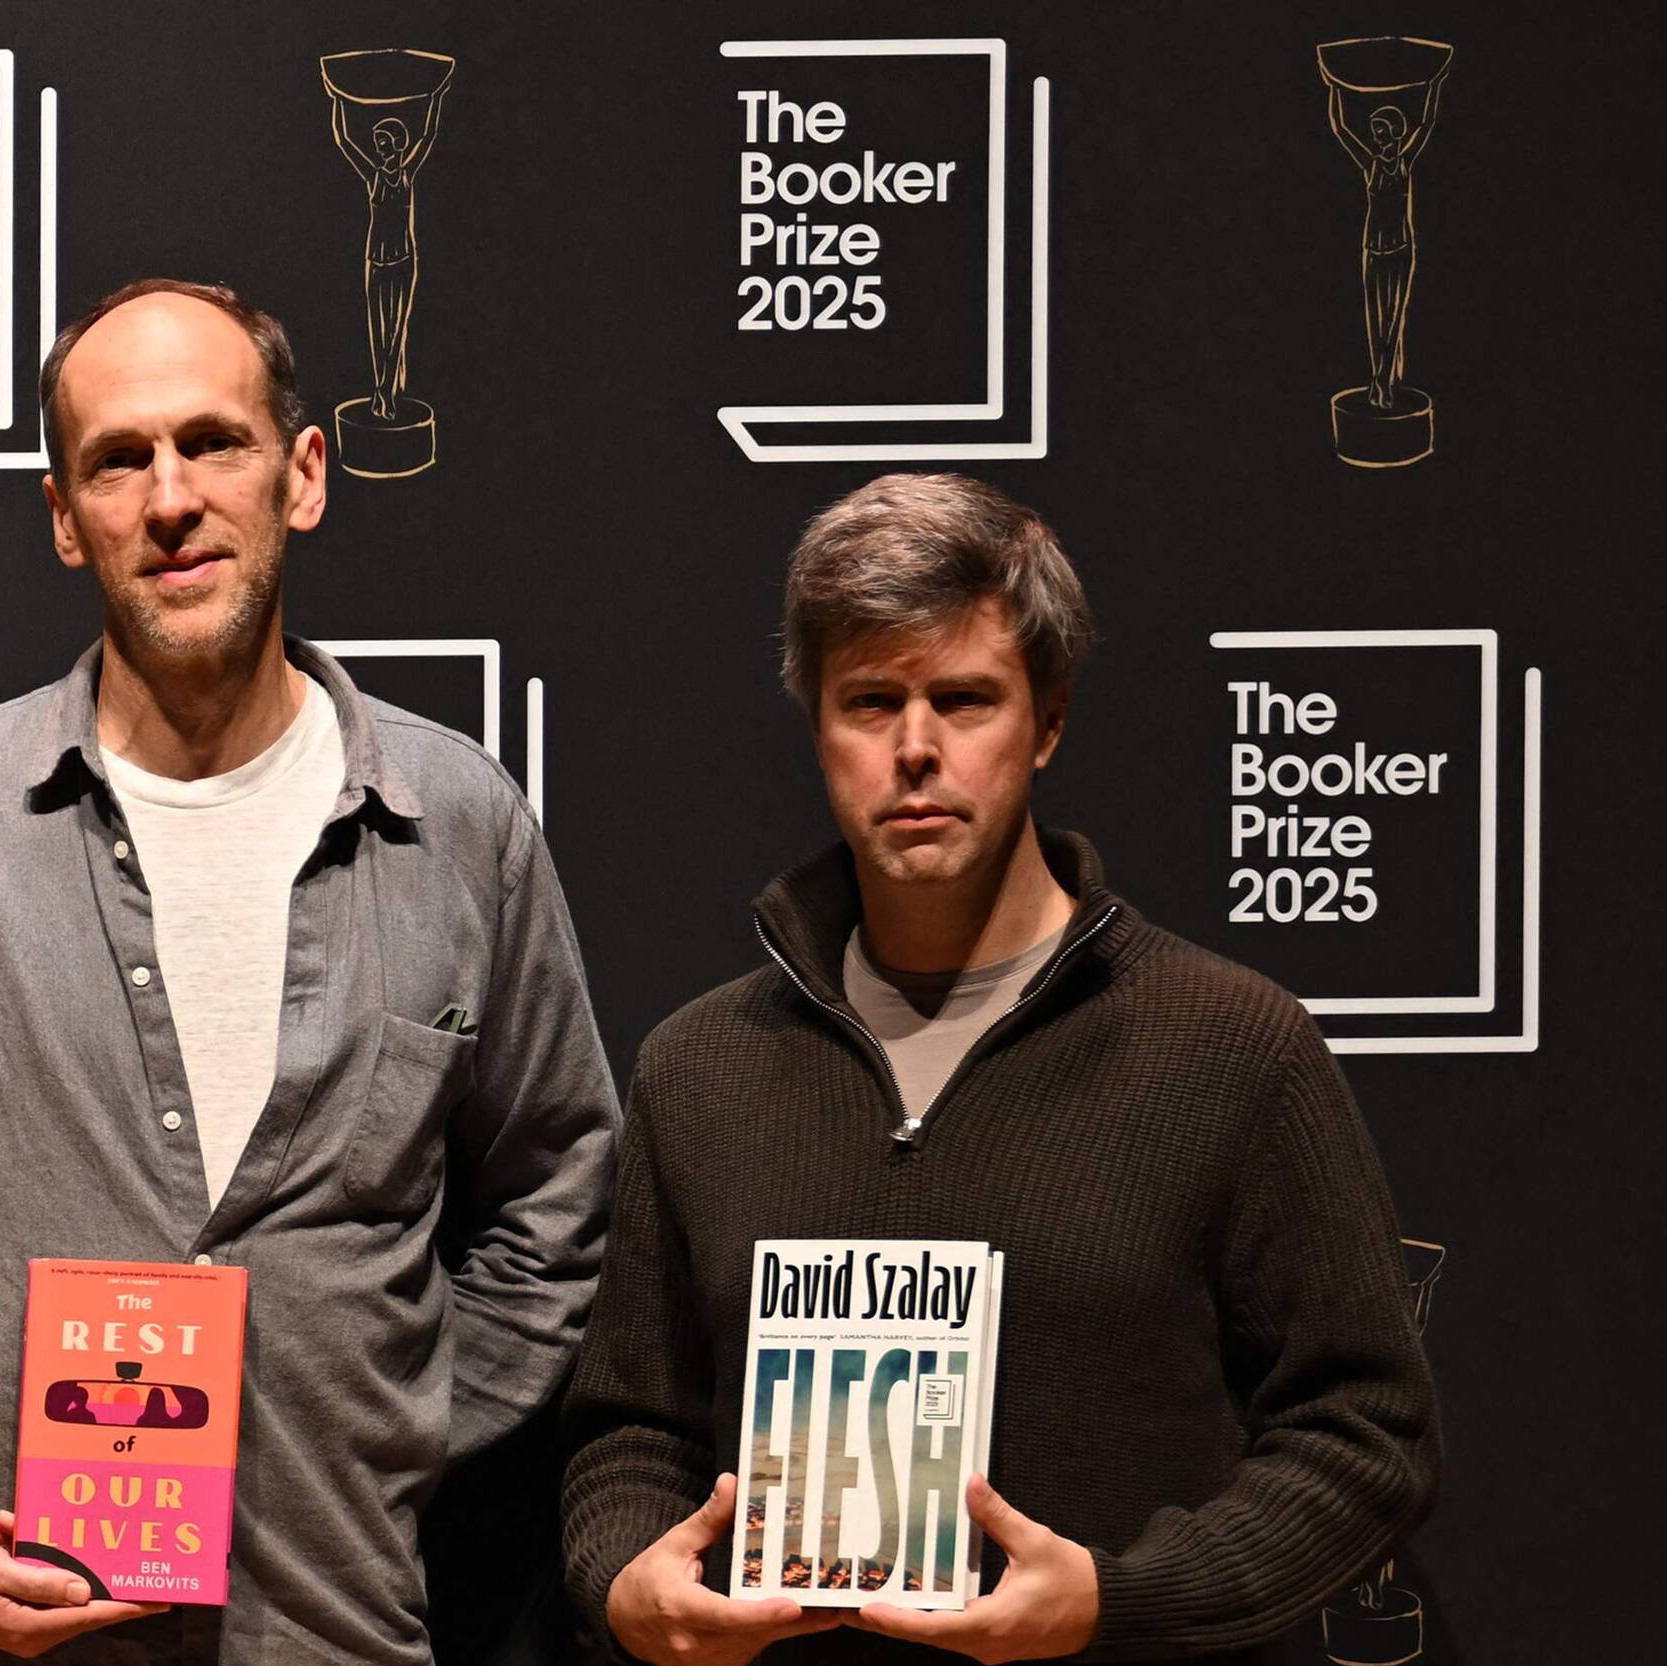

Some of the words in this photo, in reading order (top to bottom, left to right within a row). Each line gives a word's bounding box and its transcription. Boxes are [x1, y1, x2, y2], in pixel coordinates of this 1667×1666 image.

[738, 91, 846, 143] The
[741, 151, 955, 204] Booker
[741, 214, 880, 265] Prize
[738, 276, 885, 330] 2025
[1228, 682, 1337, 734] The
[1232, 742, 1447, 796] Booker
[1232, 805, 1371, 857] Prize
[1229, 868, 1377, 922] 2025
[117, 1294, 152, 1311] The
[760, 1250, 854, 1319] David
[861, 1250, 977, 1329] Szalay
[62, 1320, 202, 1355] REST
[113, 1436, 136, 1453] of
[741, 1348, 969, 1592] FLESH
[61, 1473, 183, 1509] OUR
[36, 1516, 202, 1555] LIVES
[111, 1575, 200, 1591] MARKOVITS
[140, 1561, 171, 1574] BEN
